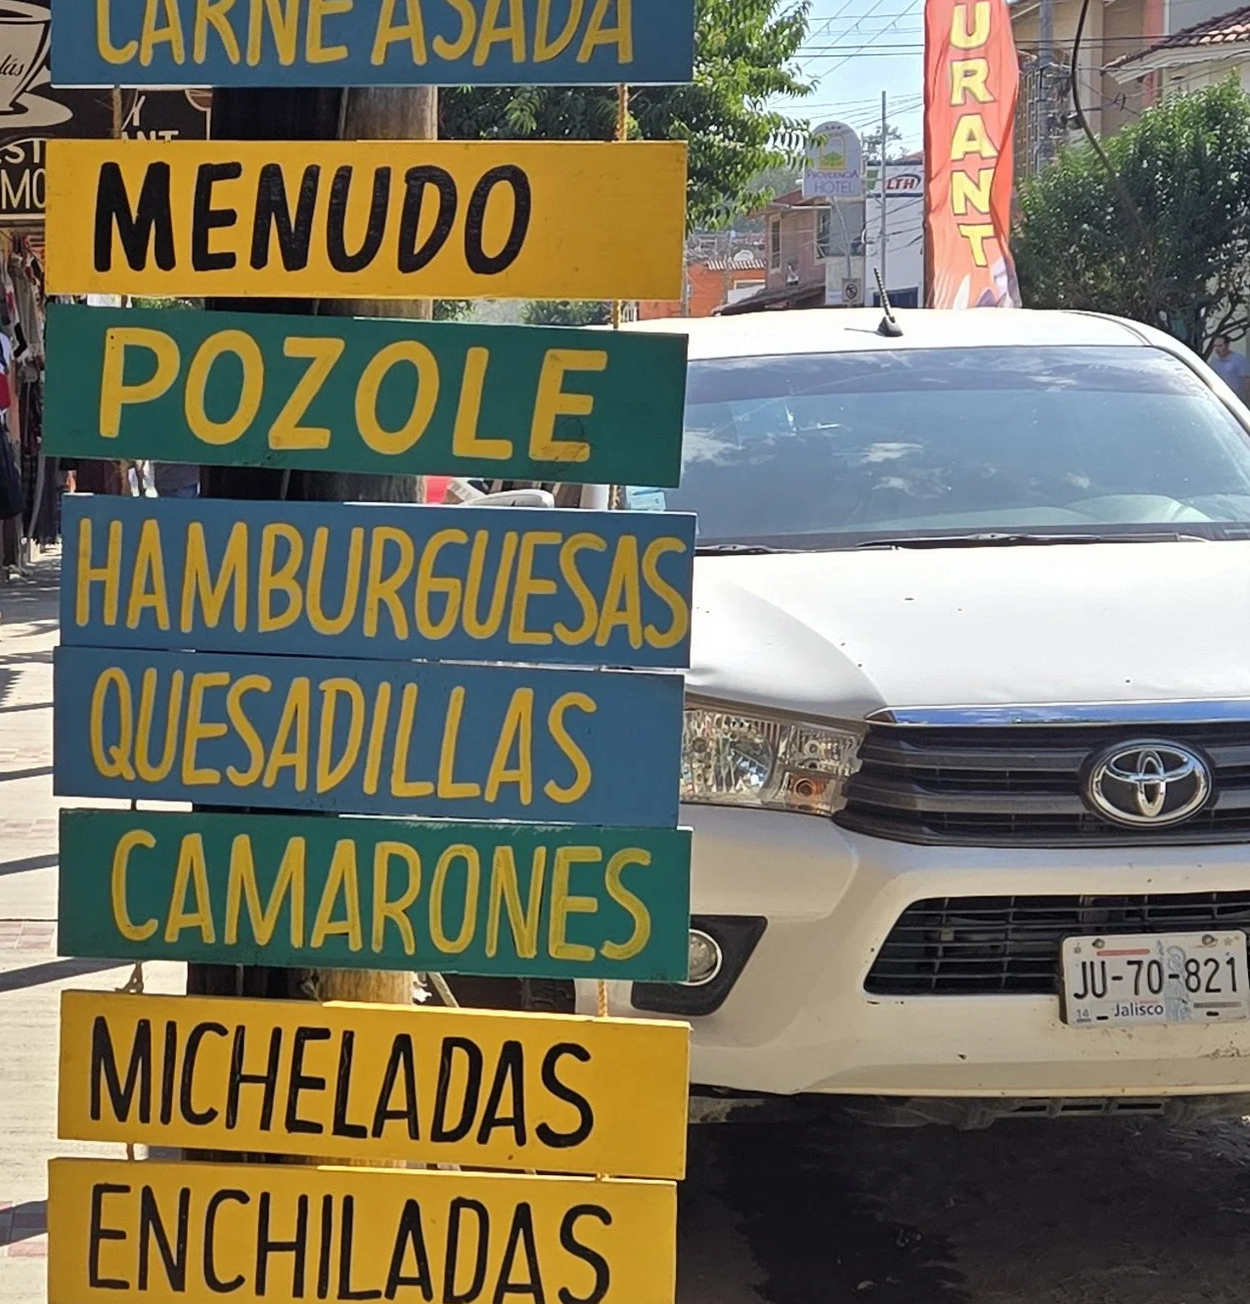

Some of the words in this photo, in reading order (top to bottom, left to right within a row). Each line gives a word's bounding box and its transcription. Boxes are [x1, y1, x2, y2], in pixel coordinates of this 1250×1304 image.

[94, 161, 531, 276] MENUDO
[814, 180, 855, 194] HOTEL
[886, 177, 916, 190] LTH
[99, 327, 607, 462] POZOLE
[76, 518, 688, 650] HAMBURGUESAS
[90, 667, 597, 805] QUESADILLAS
[112, 829, 651, 960] CAMARONES
[1073, 956, 1238, 1000] JU-70-821
[1114, 1002, 1164, 1017] Jalisco
[90, 1016, 594, 1148] MICHELADAS
